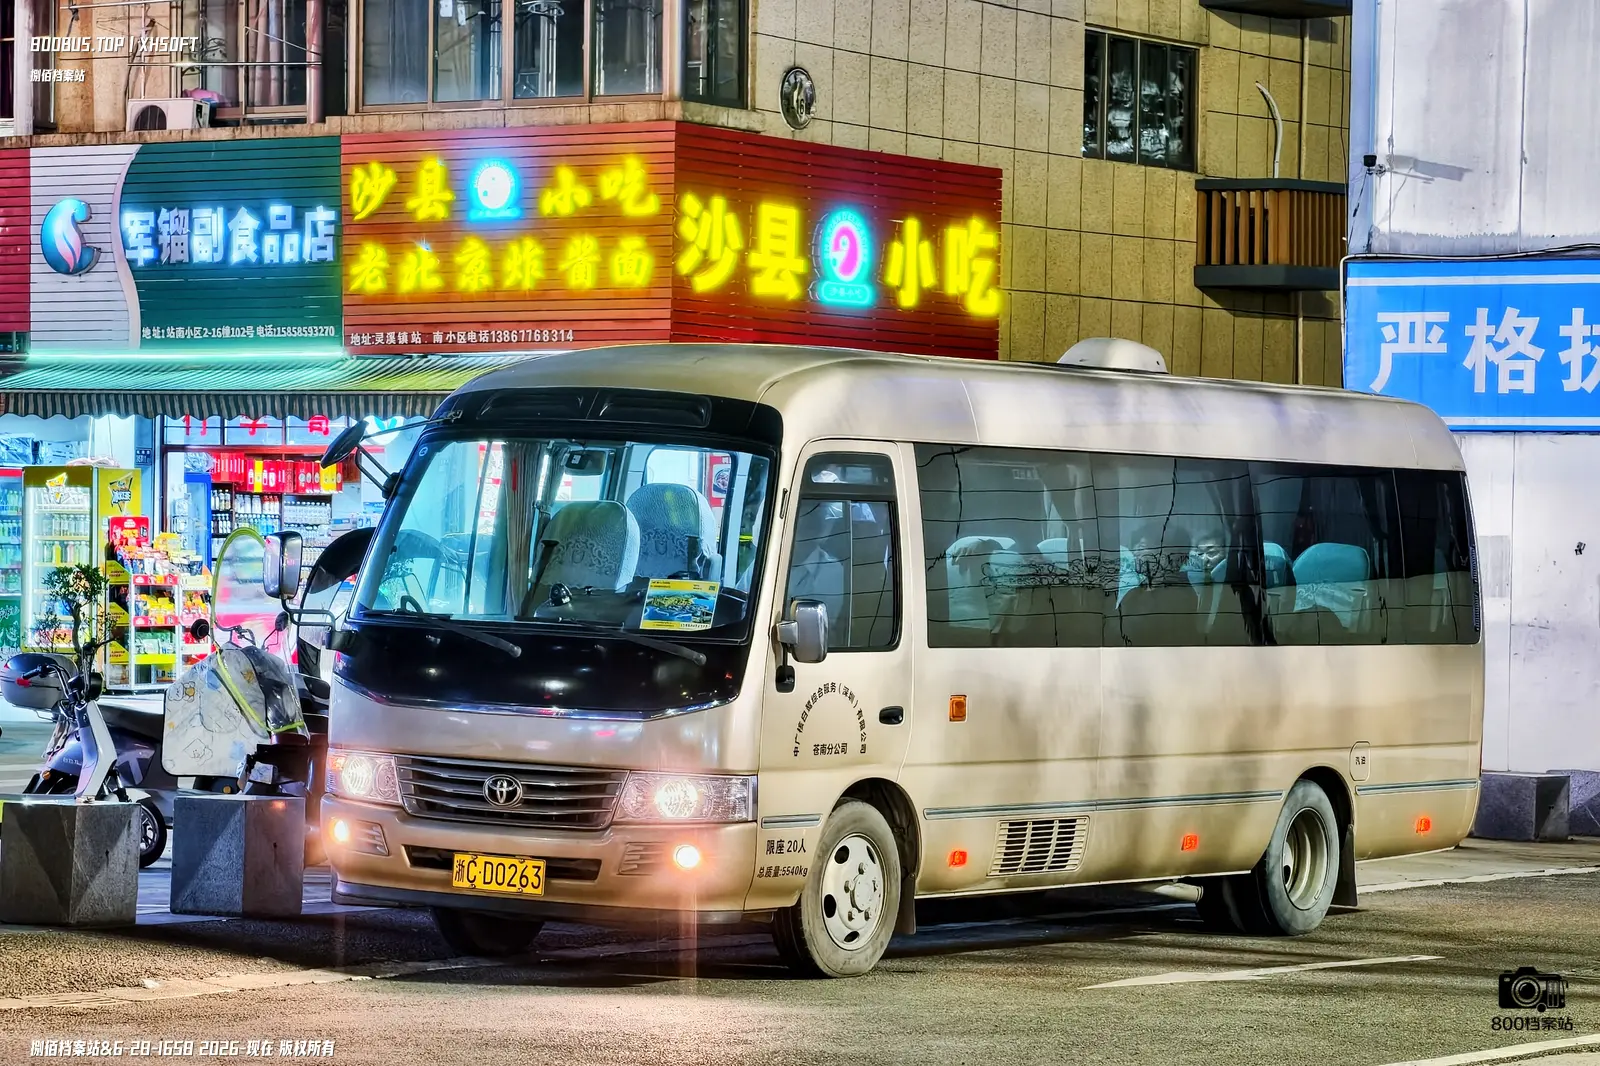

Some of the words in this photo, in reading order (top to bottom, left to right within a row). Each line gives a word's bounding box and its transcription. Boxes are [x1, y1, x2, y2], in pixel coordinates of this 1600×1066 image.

[351, 156, 455, 222] 沙县
[539, 156, 661, 217] 小吃
[349, 233, 656, 294] 老北京炸酱面
[676, 192, 807, 300] 沙县
[884, 216, 1000, 316] 小吃
[812, 742, 848, 756] 苍南分公司
[756, 865, 809, 879] 总质量:5540kg
